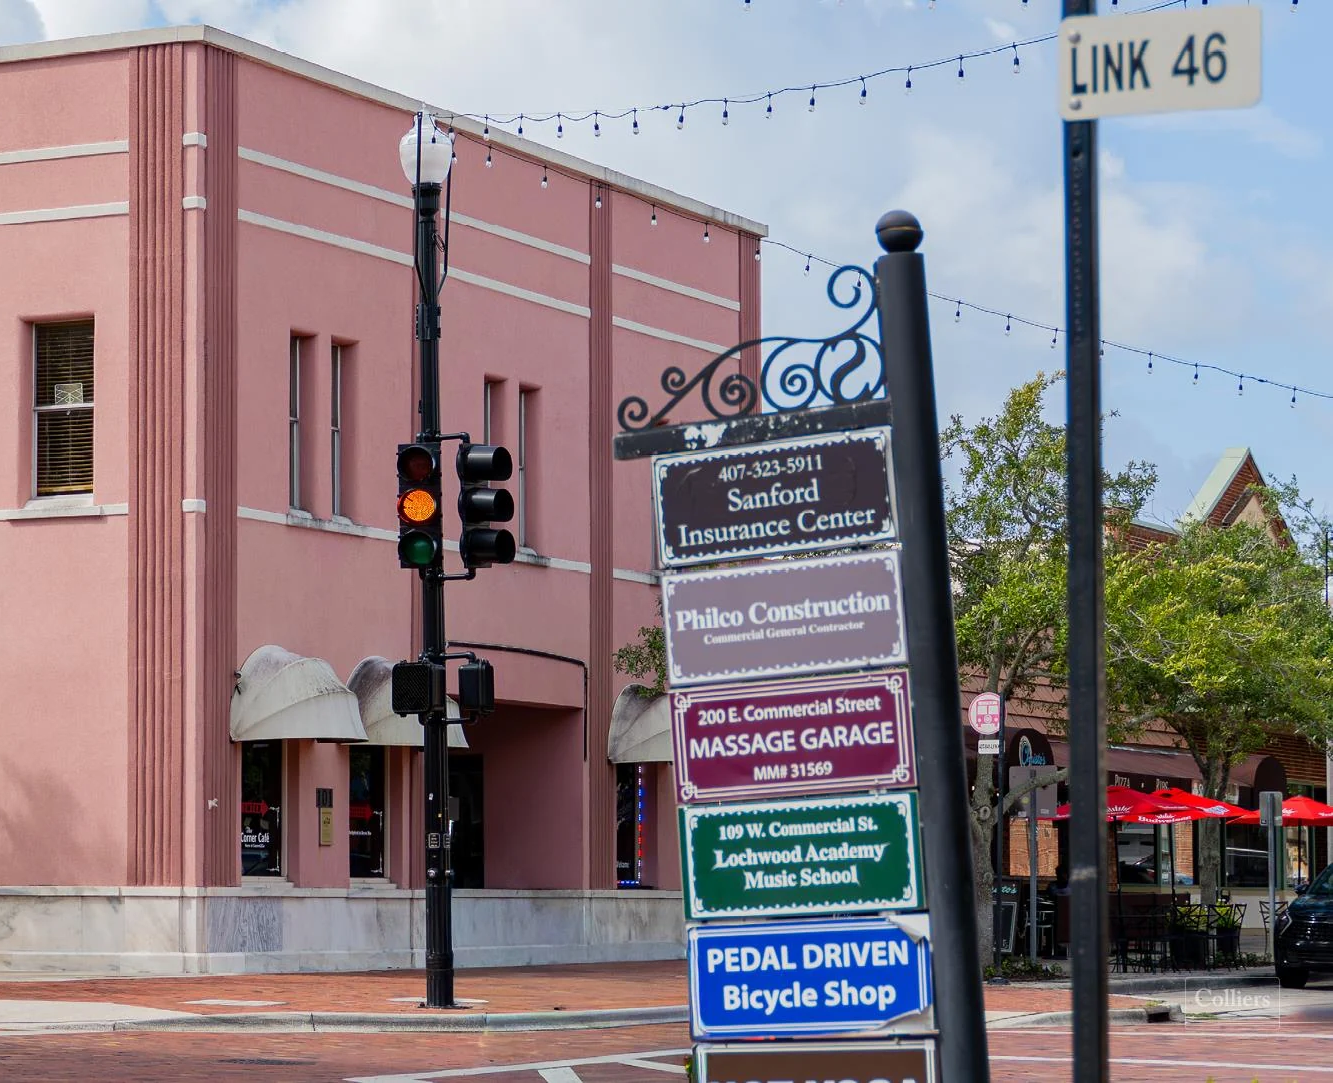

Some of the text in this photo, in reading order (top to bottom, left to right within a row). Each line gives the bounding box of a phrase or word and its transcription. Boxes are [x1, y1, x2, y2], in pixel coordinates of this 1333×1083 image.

[1071, 32, 1228, 95] LINK 46
[718, 455, 823, 482] 407-323-5911
[727, 479, 820, 512] Sanford
[678, 509, 877, 547] Insurance Center
[675, 591, 891, 631] Philco Construction
[703, 620, 864, 645] Commercial General Contractor
[698, 695, 881, 726] 200 E. Commercial Street
[689, 722, 895, 759] MASSAGE GARAGE
[754, 761, 833, 781] MM# 31569
[719, 815, 878, 841] 109 W. Commercial St.
[1137, 815, 1192, 824] Budweiser
[240, 832, 270, 843] Corner Café
[712, 841, 889, 870] Lochwood Academy
[743, 864, 860, 890] Music School
[707, 940, 909, 973] PEDAL DRIVEN
[722, 979, 897, 1015] Bicycle Shop
